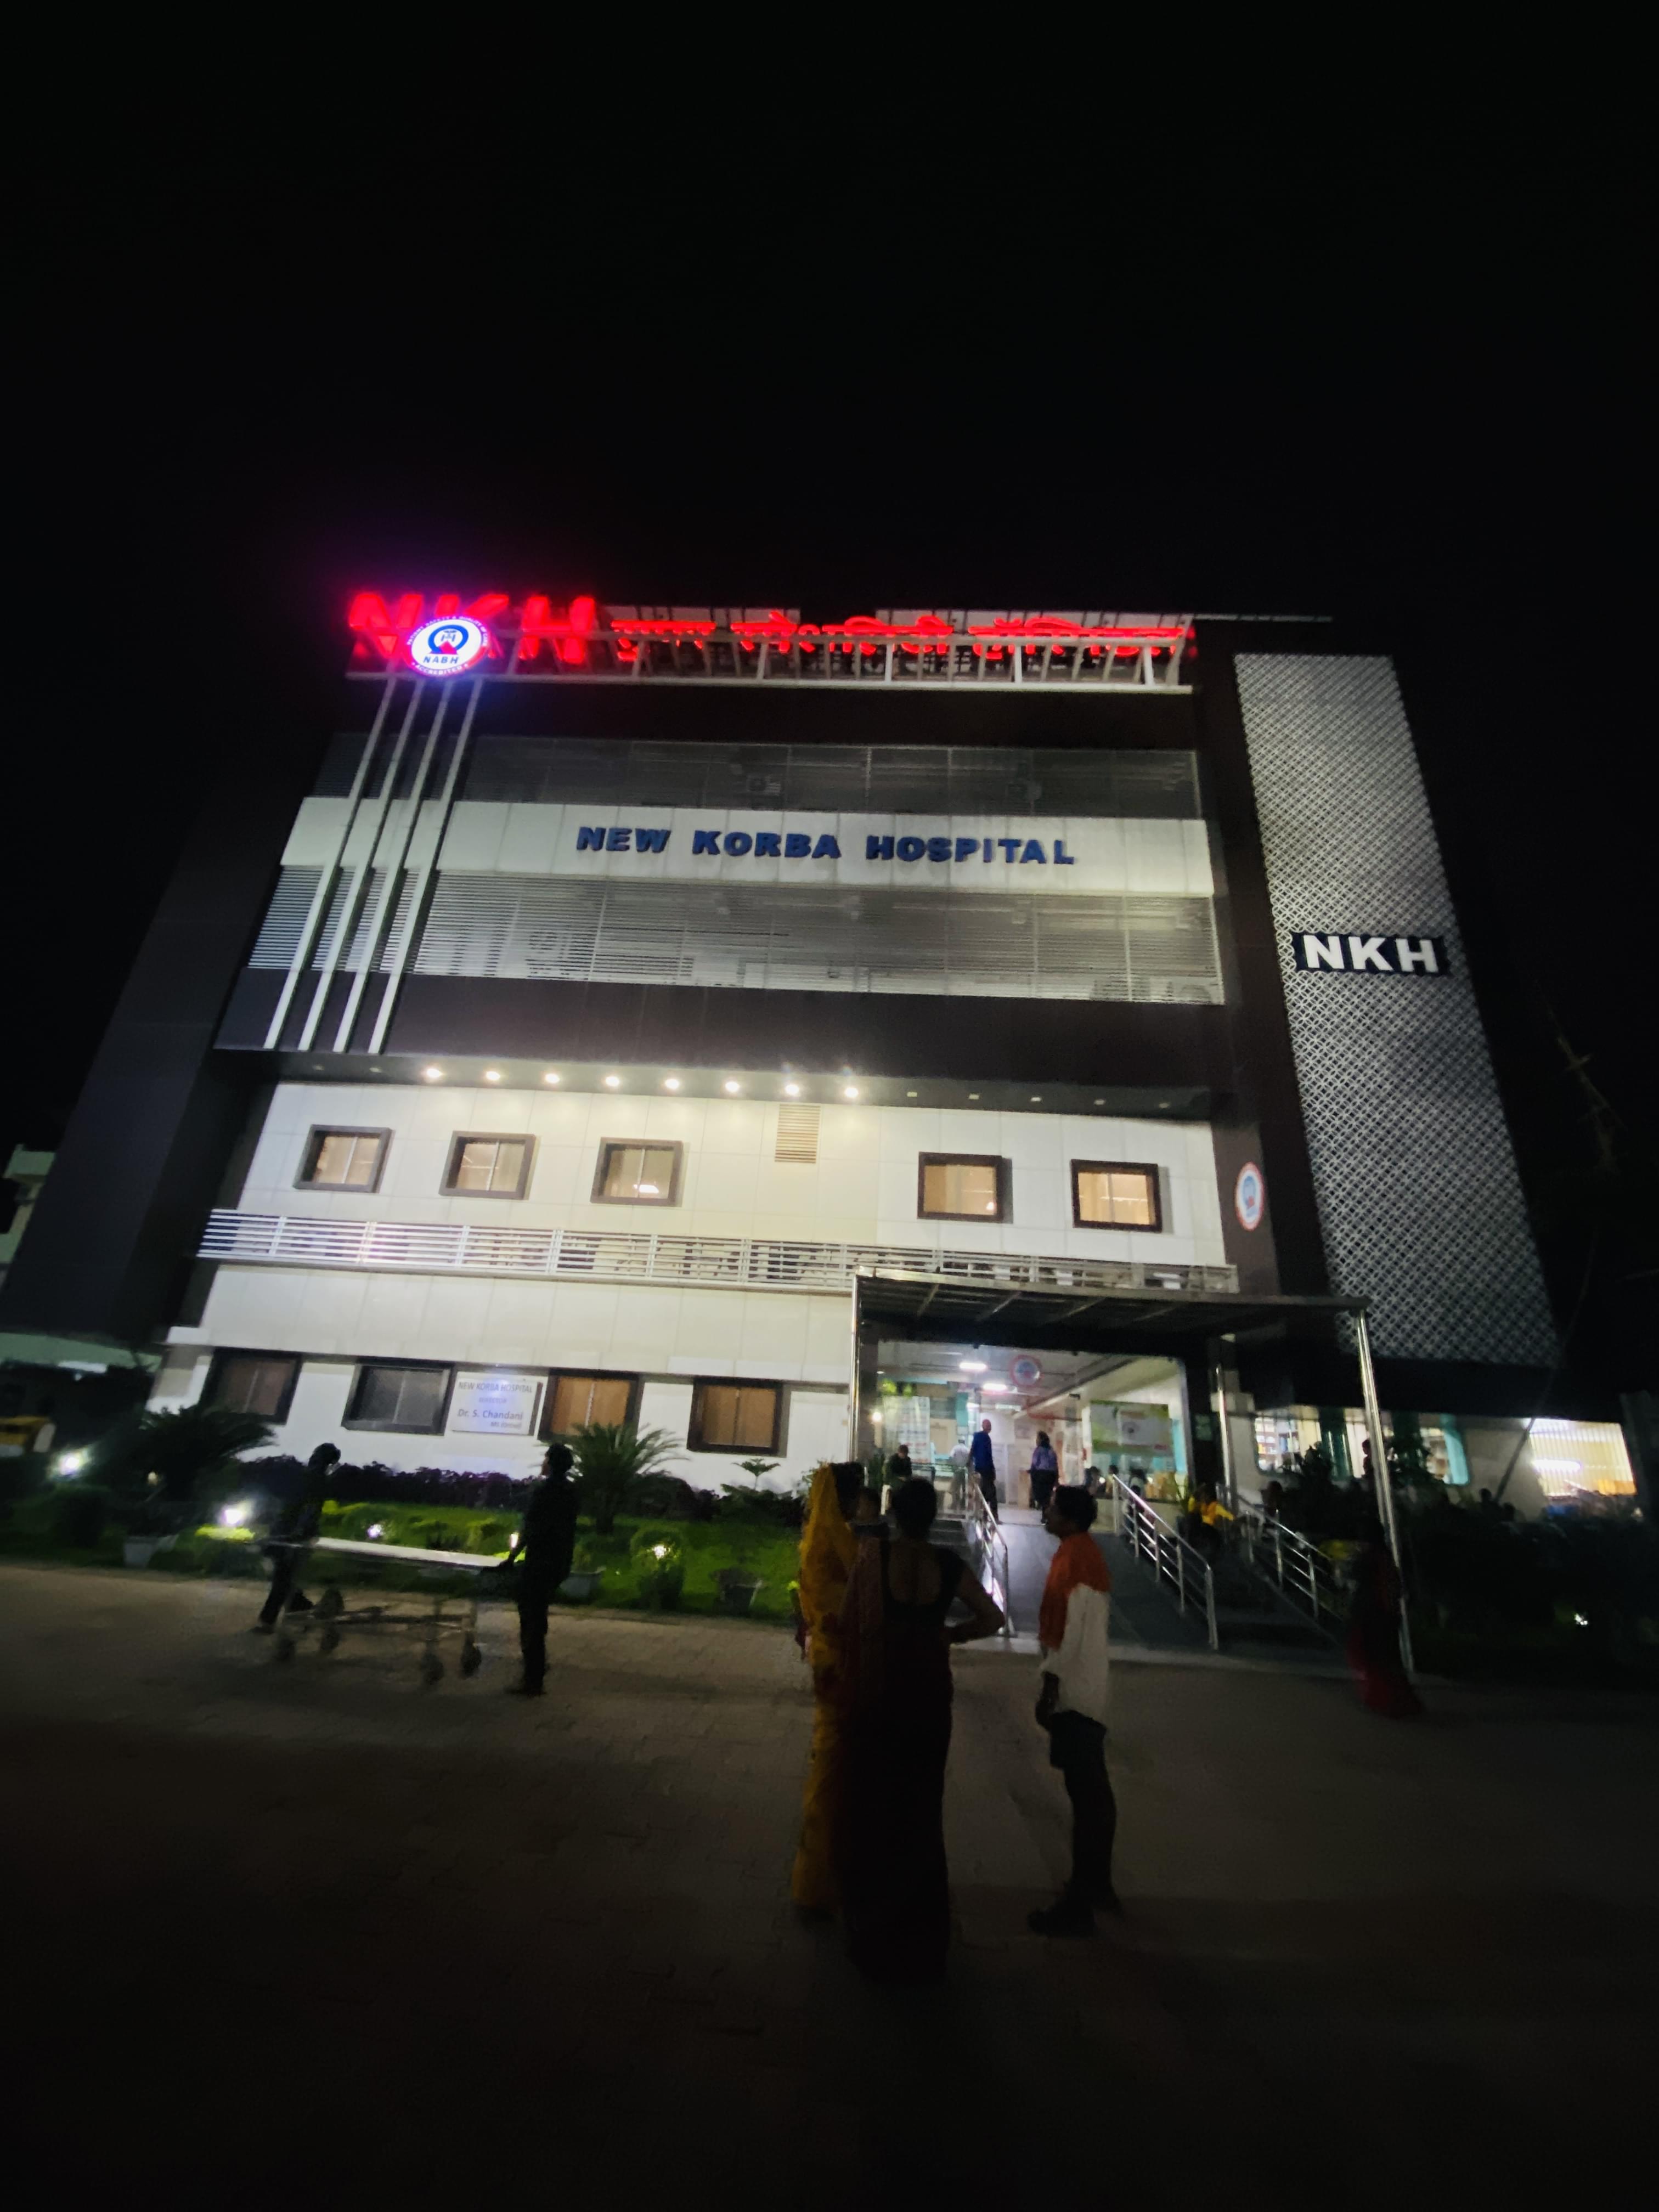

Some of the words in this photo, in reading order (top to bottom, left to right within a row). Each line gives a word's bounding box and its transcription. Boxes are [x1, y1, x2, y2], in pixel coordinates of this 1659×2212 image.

[576, 826, 671, 853] NEW
[692, 830, 842, 859] KORBA
[866, 835, 1075, 865] HOSPITAL
[1303, 934, 1438, 973] NKH
[476, 1383, 499, 1391] KORBA
[500, 1384, 532, 1392] HOSPITAL
[458, 1408, 469, 1417] Dr.
[472, 1409, 479, 1418] S.
[483, 1410, 523, 1420] Chandani
